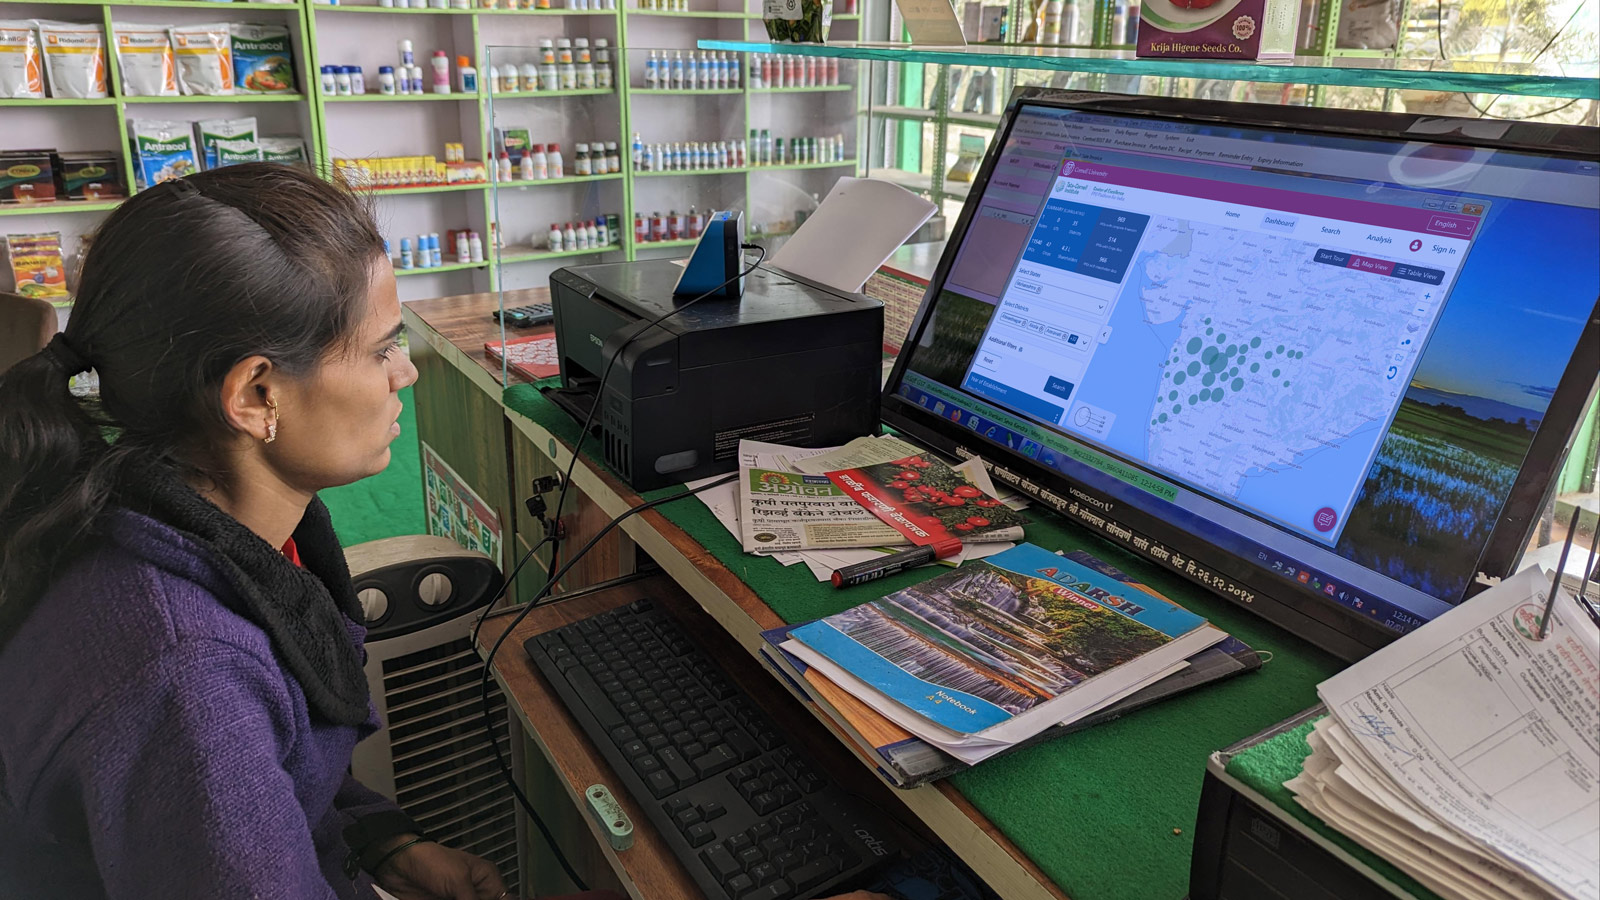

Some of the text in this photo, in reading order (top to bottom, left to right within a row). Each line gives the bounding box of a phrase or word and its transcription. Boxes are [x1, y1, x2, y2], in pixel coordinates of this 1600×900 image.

[234, 41, 283, 51] Antracol
[1150, 42, 1242, 54] Krija Higene Seeds Co.
[144, 142, 187, 151] Antracol
[223, 152, 258, 160] Antracol
[1195, 149, 1215, 157] Payment
[1219, 152, 1241, 160] Reminder
[1273, 158, 1304, 167] Information
[1088, 168, 1108, 177] University
[1067, 182, 1088, 190] Tata-Cornell
[1225, 210, 1241, 218] Home
[1265, 216, 1295, 228] Dashboard
[1434, 220, 1457, 230] English
[1321, 226, 1341, 236] Search
[1367, 234, 1392, 244] Analysis
[1432, 244, 1448, 255] Sign
[1361, 260, 1374, 269] Map
[1029, 270, 1041, 278] States
[1407, 268, 1438, 280] Table View
[1004, 300, 1029, 312] Select Districts
[590, 333, 603, 348] EPSON
[989, 336, 1017, 350] Additional filters
[983, 356, 994, 364] Reset
[984, 380, 1008, 394] Establishment
[1052, 382, 1066, 392] Search
[1222, 422, 1245, 434] Hyderabad
[1069, 486, 1104, 508] VIDEOCON
[1164, 489, 1175, 499] PM
[751, 498, 777, 508] कृषी
[861, 491, 895, 514] फवारणी
[891, 510, 930, 537] वेळापत्रक
[1106, 521, 1132, 542] सोनवणे
[1172, 553, 1185, 569] भेट
[1258, 552, 1268, 561] EN
[1036, 567, 1146, 616] ADARSH
[1056, 588, 1098, 610] Winner
[1393, 610, 1412, 624] 12:14
[1488, 620, 1507, 642] Buyers
[1476, 626, 1509, 666] Buyers GSTIN
[936, 690, 976, 715] Notebook
[1364, 691, 1384, 714] Receipt
[1387, 707, 1404, 728] Words
[854, 830, 888, 856] artis
